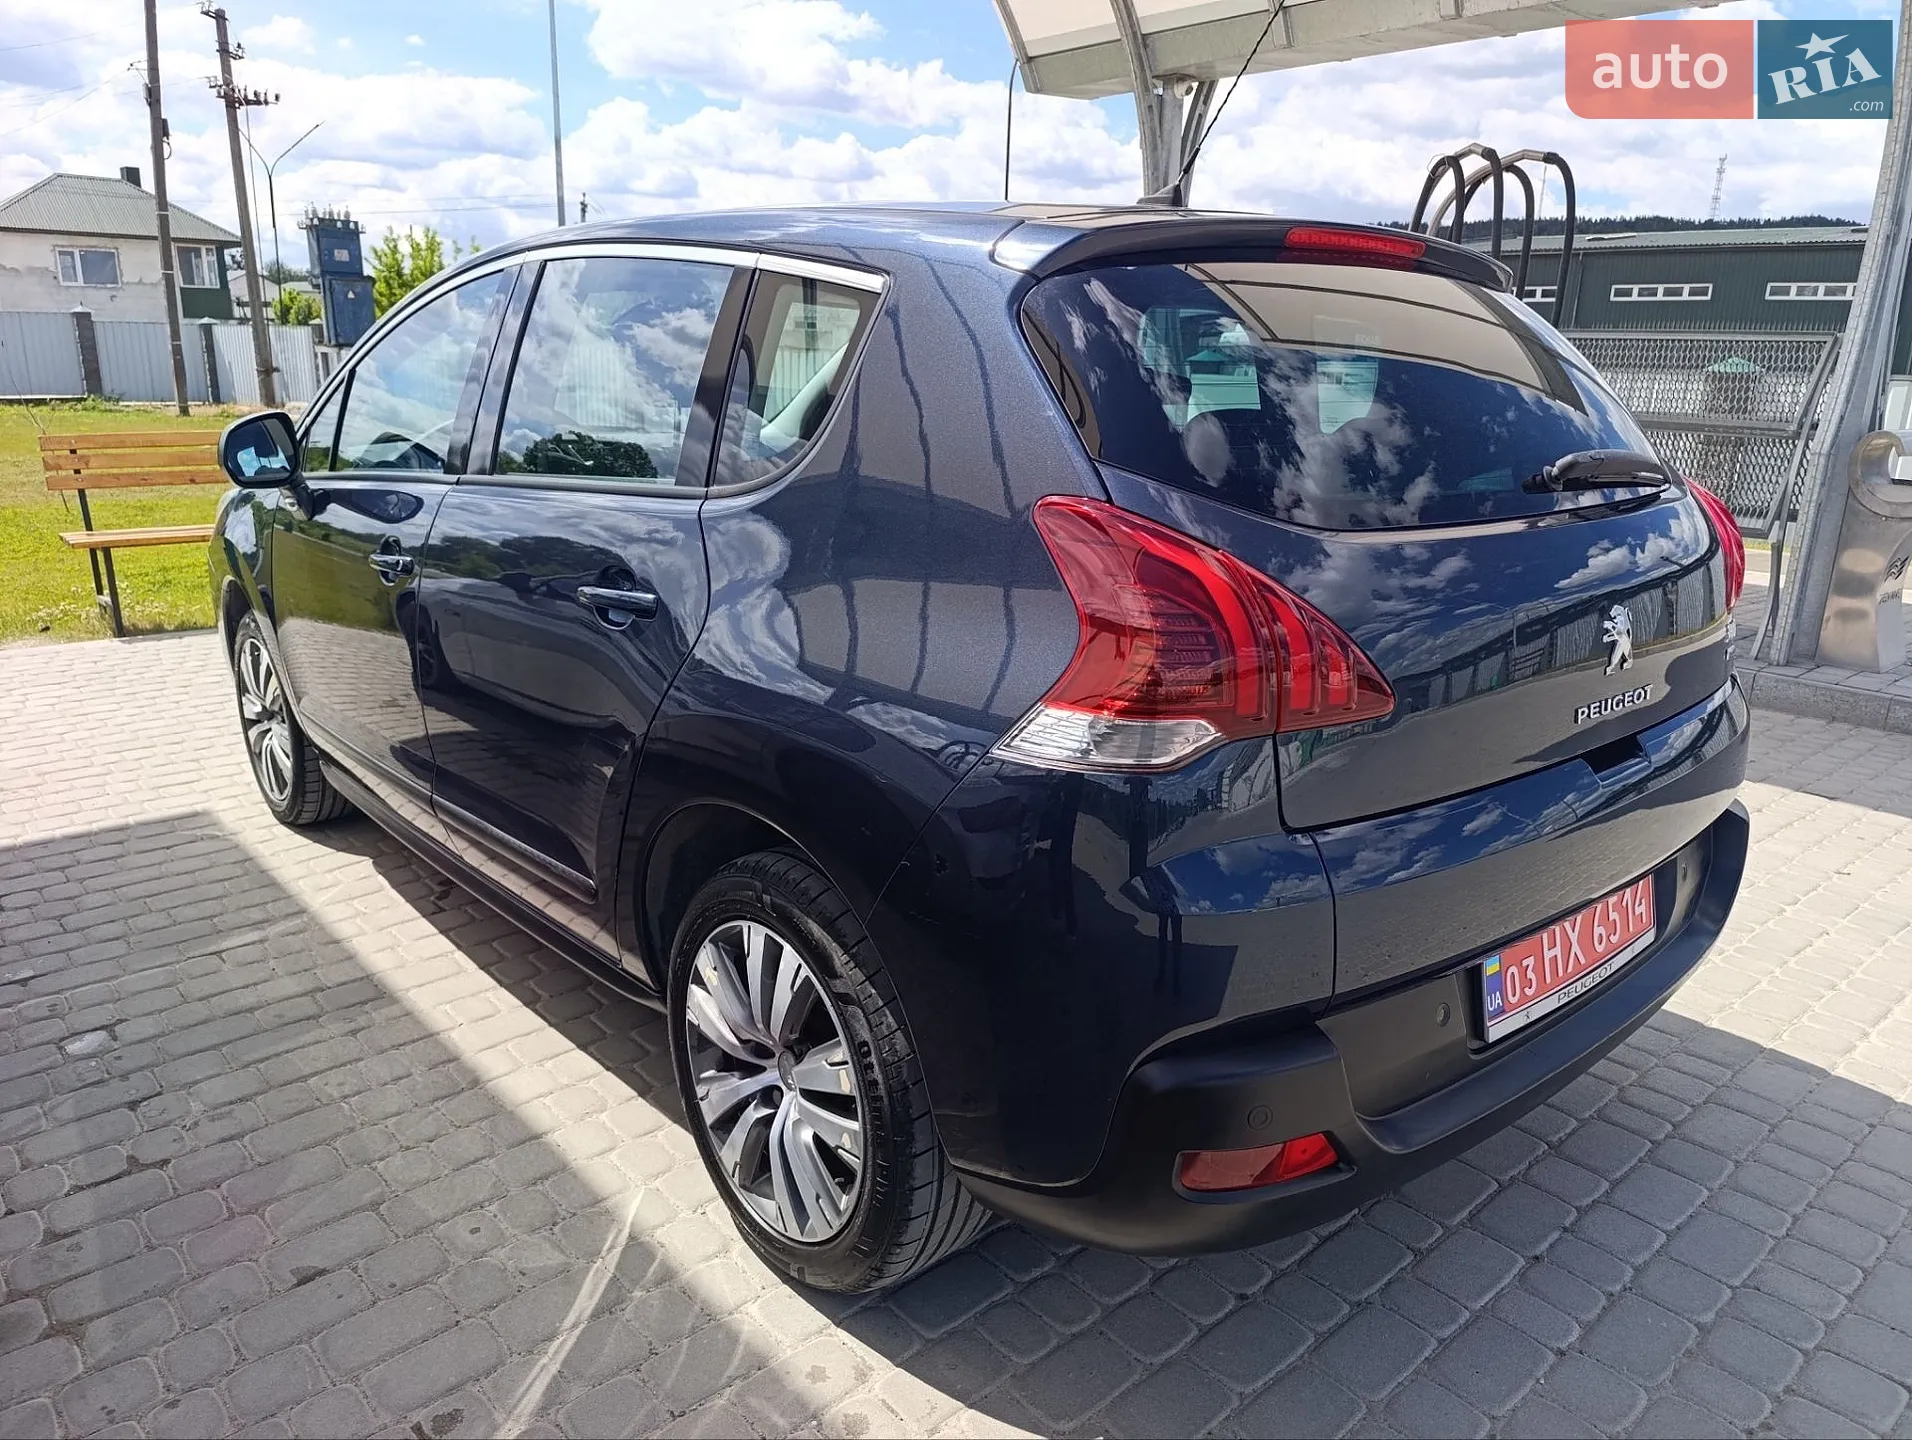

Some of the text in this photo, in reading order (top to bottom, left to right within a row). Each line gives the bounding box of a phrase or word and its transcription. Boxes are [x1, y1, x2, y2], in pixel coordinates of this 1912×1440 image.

[1574, 683, 1654, 724] PEUGEOT
[1505, 879, 1648, 1005] 03 HX 6514
[1487, 991, 1503, 1011] UA
[1557, 962, 1614, 1005] PEUGEOT
